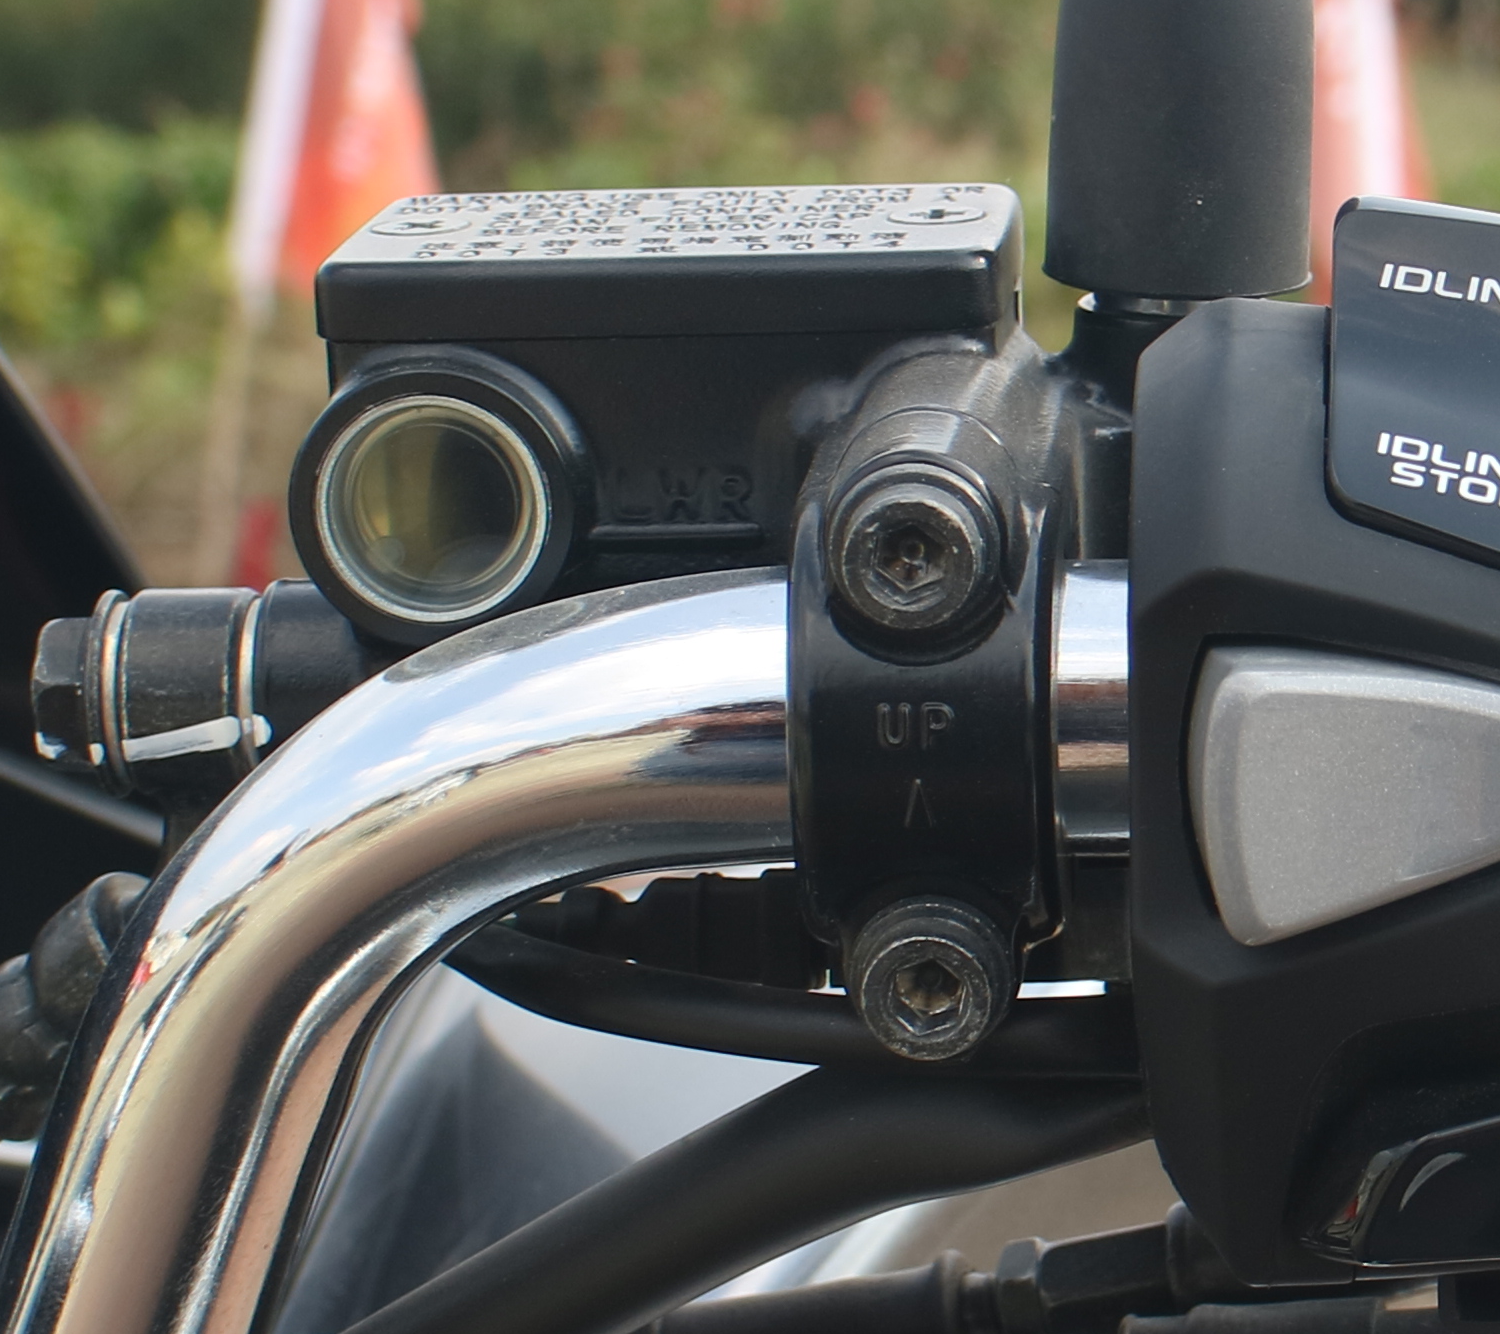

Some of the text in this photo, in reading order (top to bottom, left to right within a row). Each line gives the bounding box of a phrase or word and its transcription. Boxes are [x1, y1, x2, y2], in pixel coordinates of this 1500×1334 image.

[608, 192, 678, 205] USE
[702, 188, 796, 200] ONLY
[940, 185, 987, 195] OR
[399, 194, 957, 215] DOT4 BRAKE FLUID FROM A
[488, 212, 872, 229] CLEAN FILLER CAP
[493, 208, 641, 220] SEALED
[480, 224, 629, 237] BEFORE
[877, 701, 955, 750] UP
